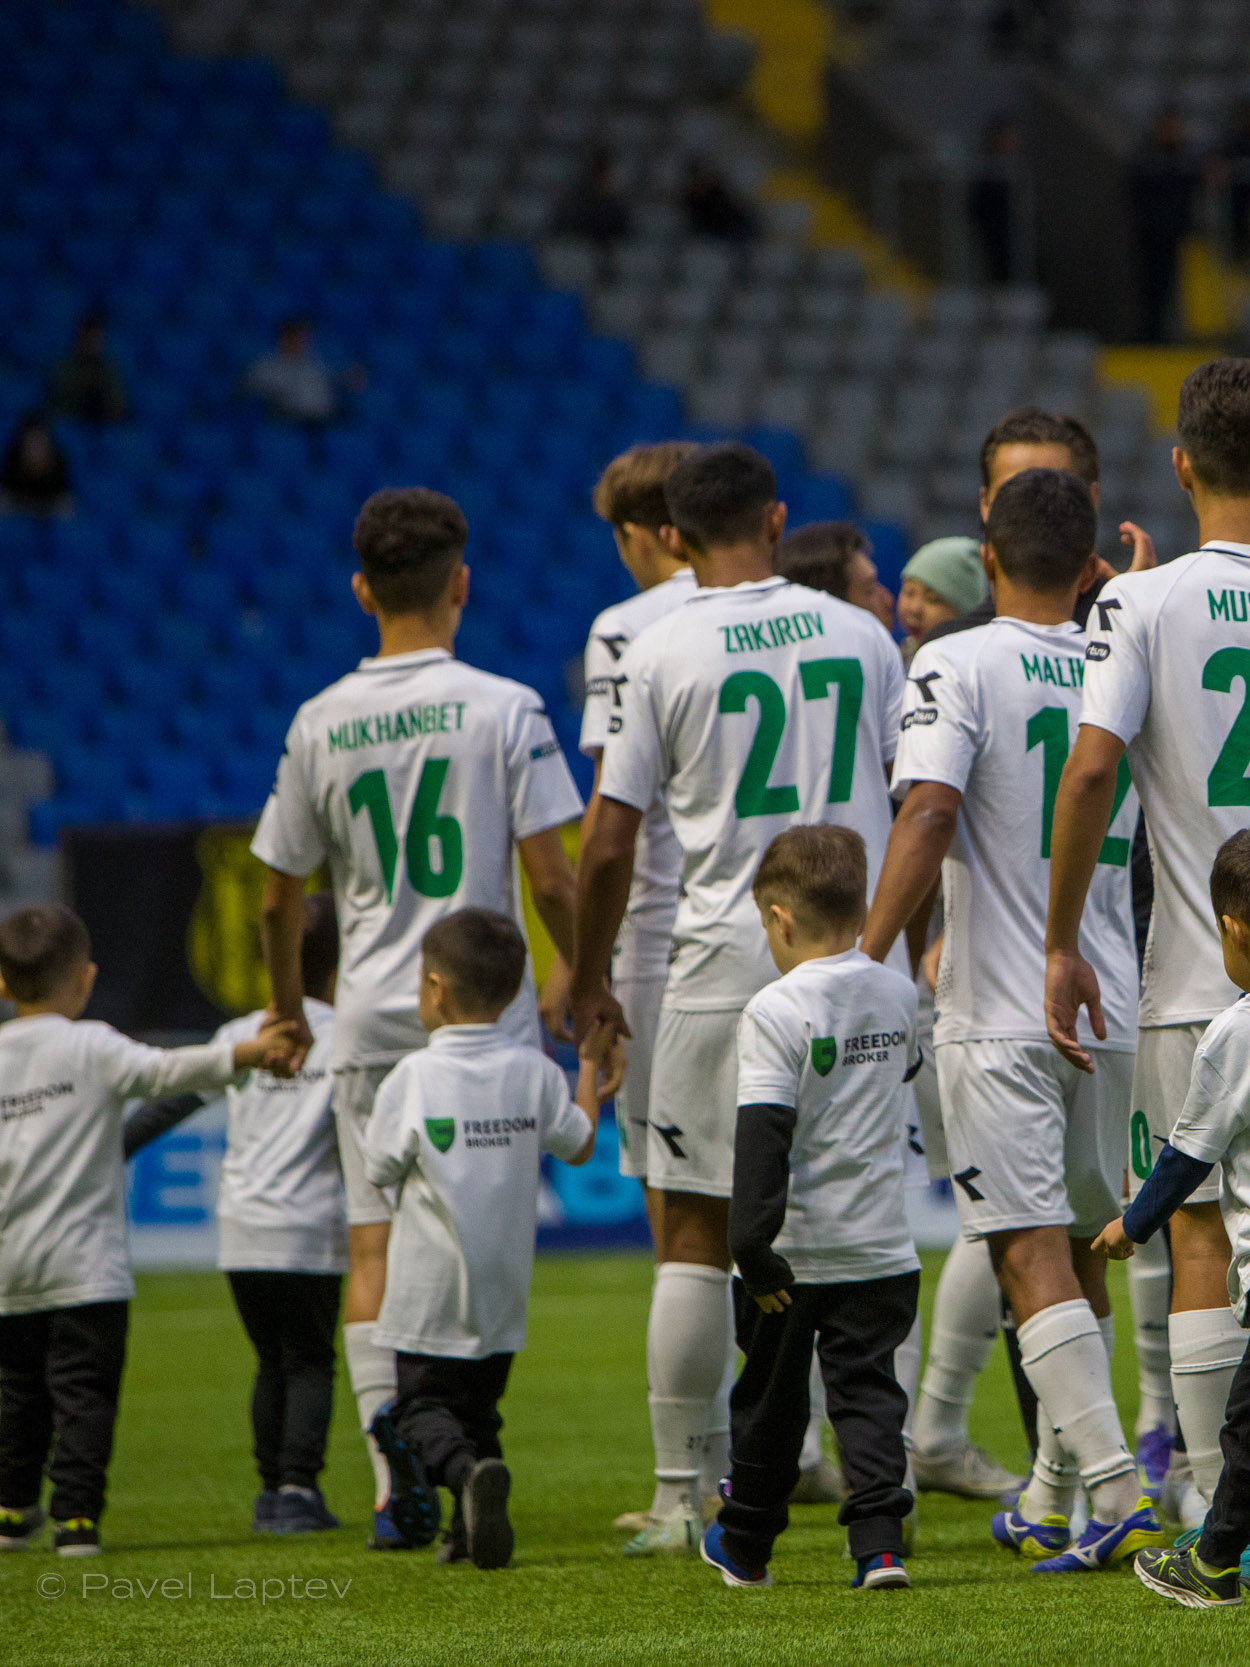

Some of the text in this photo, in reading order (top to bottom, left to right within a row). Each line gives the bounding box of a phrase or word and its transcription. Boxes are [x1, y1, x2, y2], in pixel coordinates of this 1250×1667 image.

[717, 612, 826, 653] ZAKIROV
[327, 702, 466, 754] MUKHANBET
[718, 658, 864, 819] 27
[347, 757, 463, 905] 16
[463, 1117, 537, 1135] FREEDOM
[465, 1136, 511, 1149] BROKER
